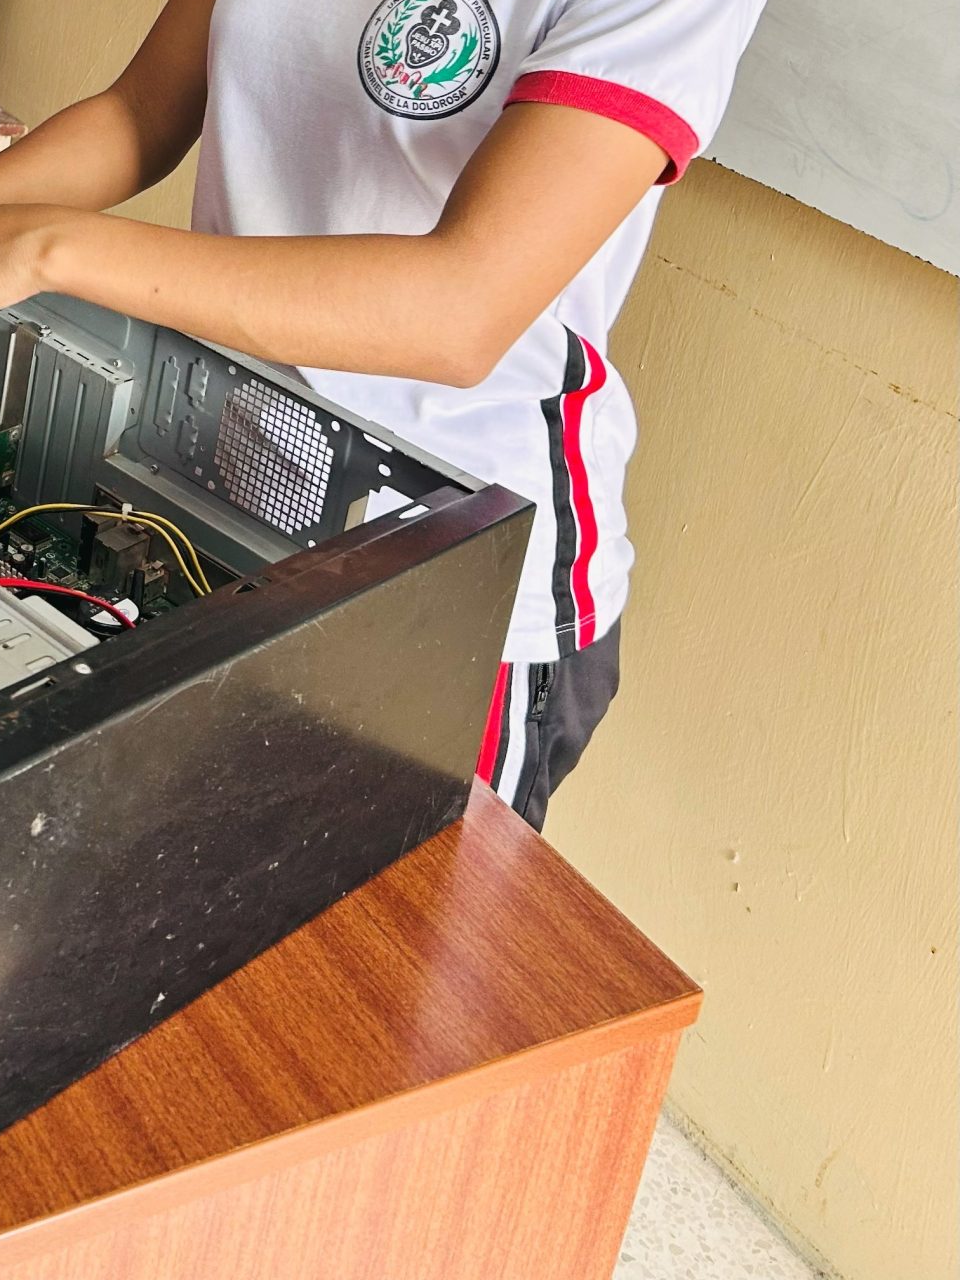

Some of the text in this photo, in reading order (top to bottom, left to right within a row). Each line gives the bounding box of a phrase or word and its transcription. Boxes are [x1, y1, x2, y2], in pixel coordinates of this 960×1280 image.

[410, 39, 437, 56] PASSIO
[472, 0, 492, 61] PARTICULAR
[364, 60, 383, 97] GABRIEL
[383, 92, 395, 105] DE
[396, 100, 409, 110] LA
